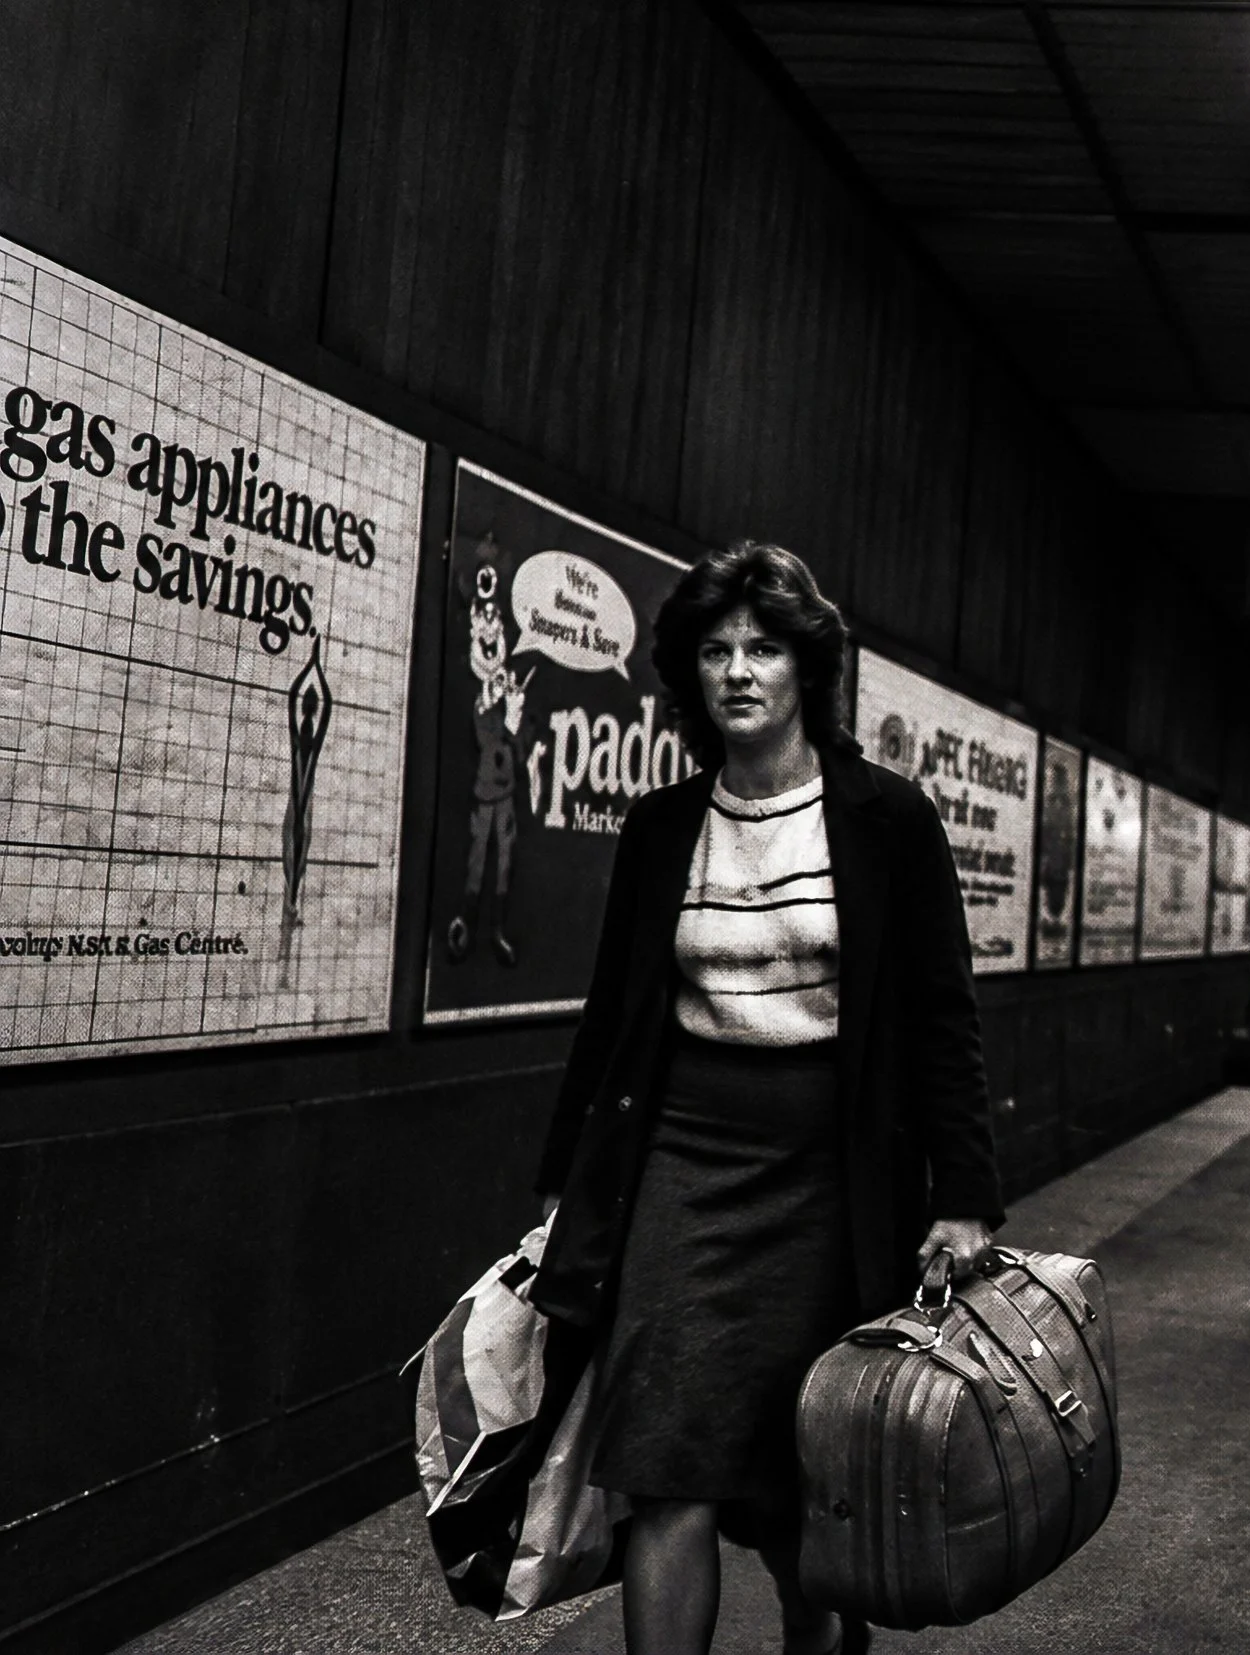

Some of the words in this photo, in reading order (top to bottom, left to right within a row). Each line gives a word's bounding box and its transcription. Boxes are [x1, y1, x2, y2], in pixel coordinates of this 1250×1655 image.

[0, 387, 116, 483] gas
[128, 432, 376, 569] appliances
[20, 481, 125, 582] the
[133, 533, 317, 655] savings.
[134, 933, 170, 956] Gas
